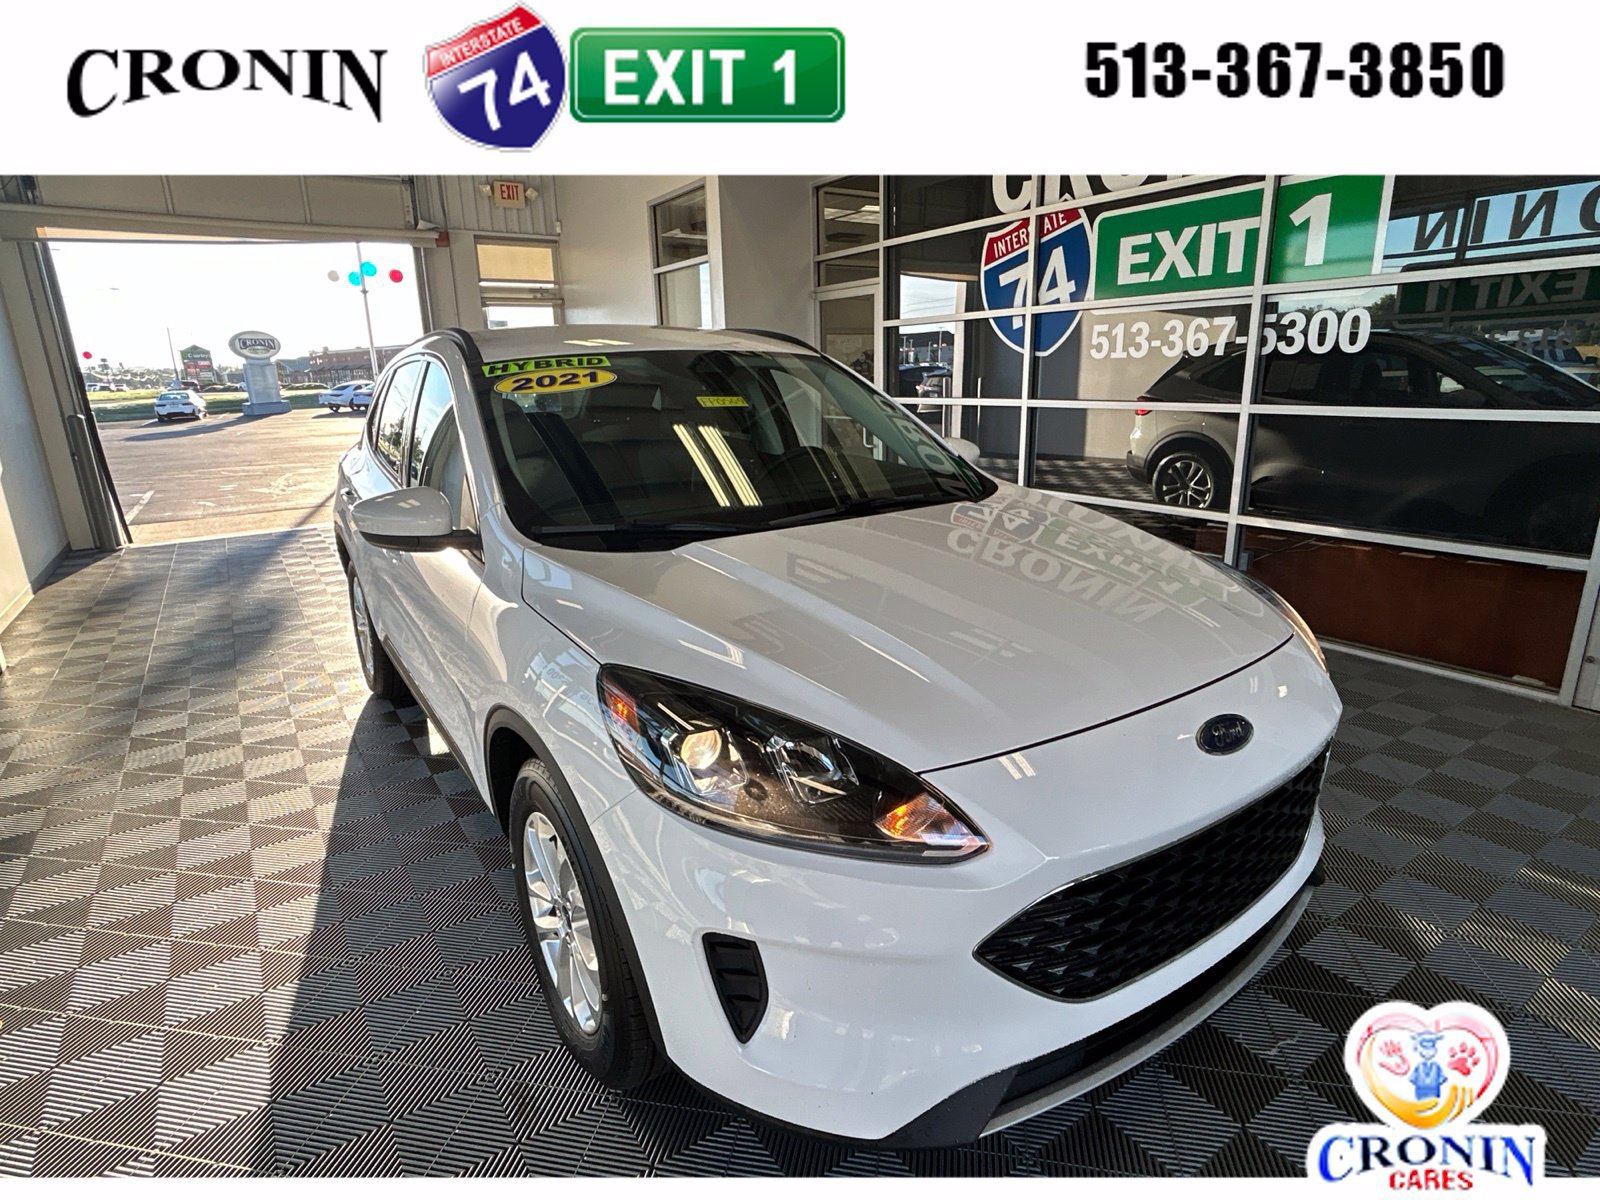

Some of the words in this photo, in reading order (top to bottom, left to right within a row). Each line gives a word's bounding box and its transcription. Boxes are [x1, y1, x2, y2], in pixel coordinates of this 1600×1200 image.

[500, 184, 519, 200] EXIT
[994, 212, 1068, 259] INTERATE
[1117, 216, 1261, 286] EXIT
[1289, 193, 1332, 267] 1
[999, 245, 1077, 330] 74
[240, 338, 276, 349] CRONIN
[488, 357, 604, 375] HYBRID
[511, 371, 599, 392] 2021
